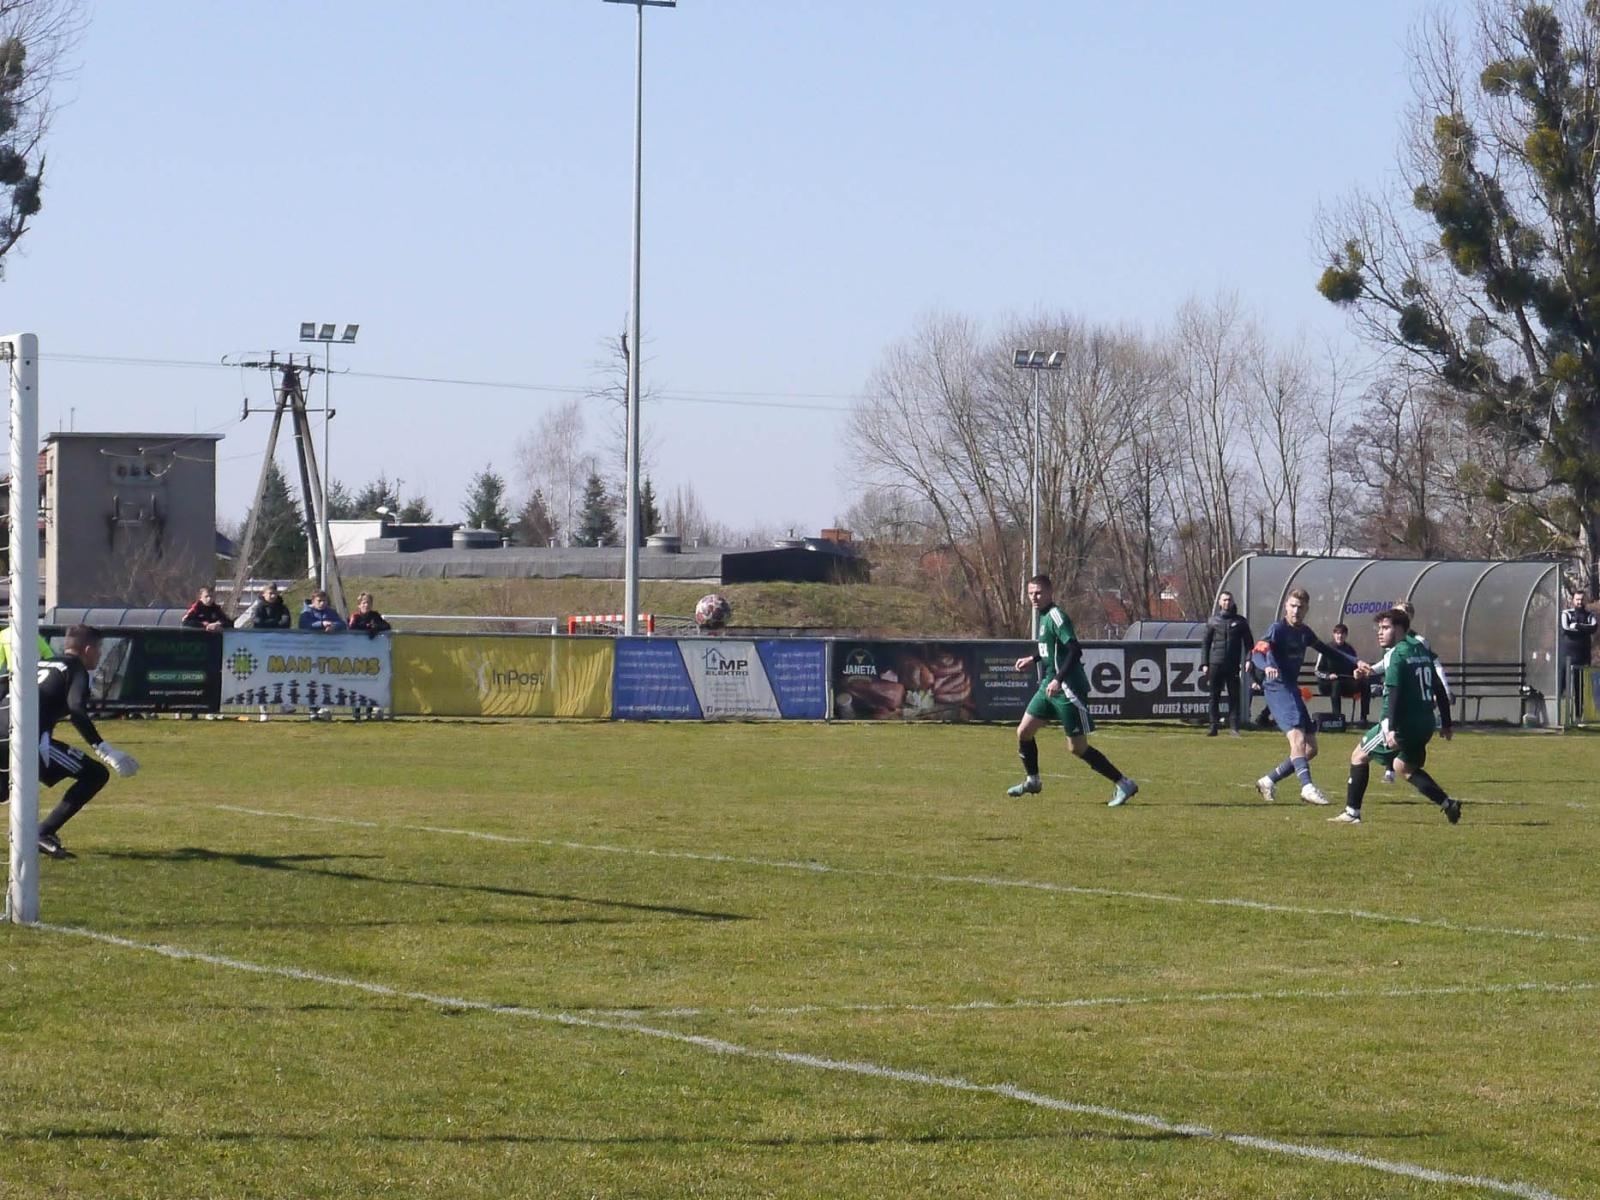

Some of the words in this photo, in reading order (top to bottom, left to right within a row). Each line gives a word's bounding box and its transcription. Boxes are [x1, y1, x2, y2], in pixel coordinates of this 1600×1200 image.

[1344, 601, 1393, 614] GOSPODAR
[267, 655, 380, 675] MAN-TRANS
[719, 660, 748, 670] MP
[842, 665, 877, 675] JANETA
[492, 669, 544, 686] InPost
[1415, 666, 1432, 701] 19
[1088, 704, 1121, 714] EEZA.PL
